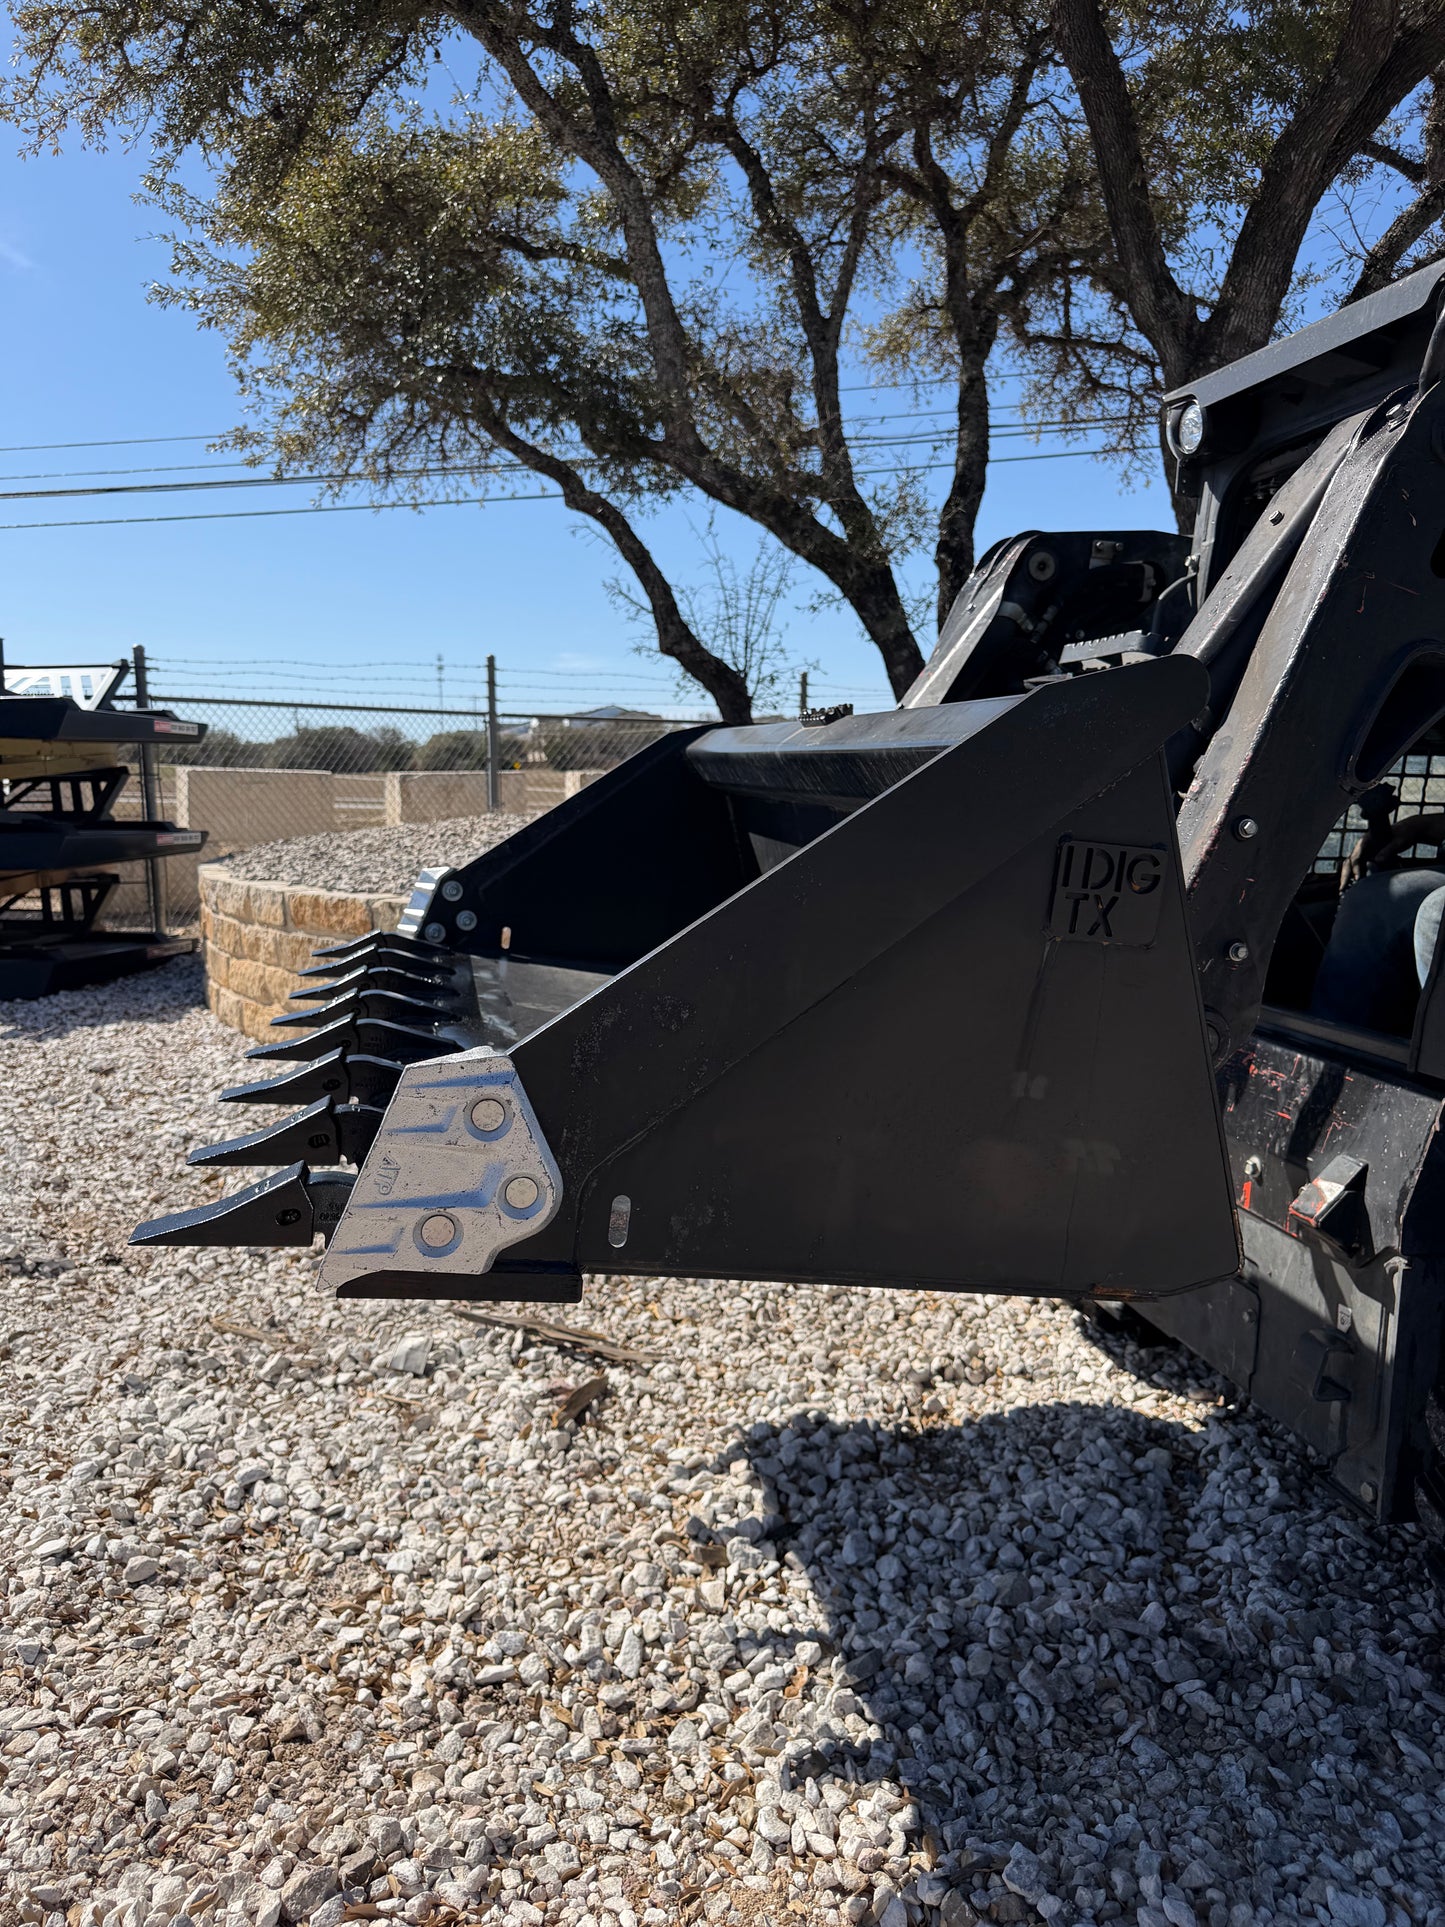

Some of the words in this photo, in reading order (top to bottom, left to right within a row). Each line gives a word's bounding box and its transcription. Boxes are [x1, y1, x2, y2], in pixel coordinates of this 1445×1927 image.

[1062, 846, 1074, 887] I
[1082, 848, 1161, 895] DIG
[1065, 894, 1119, 937] TX
